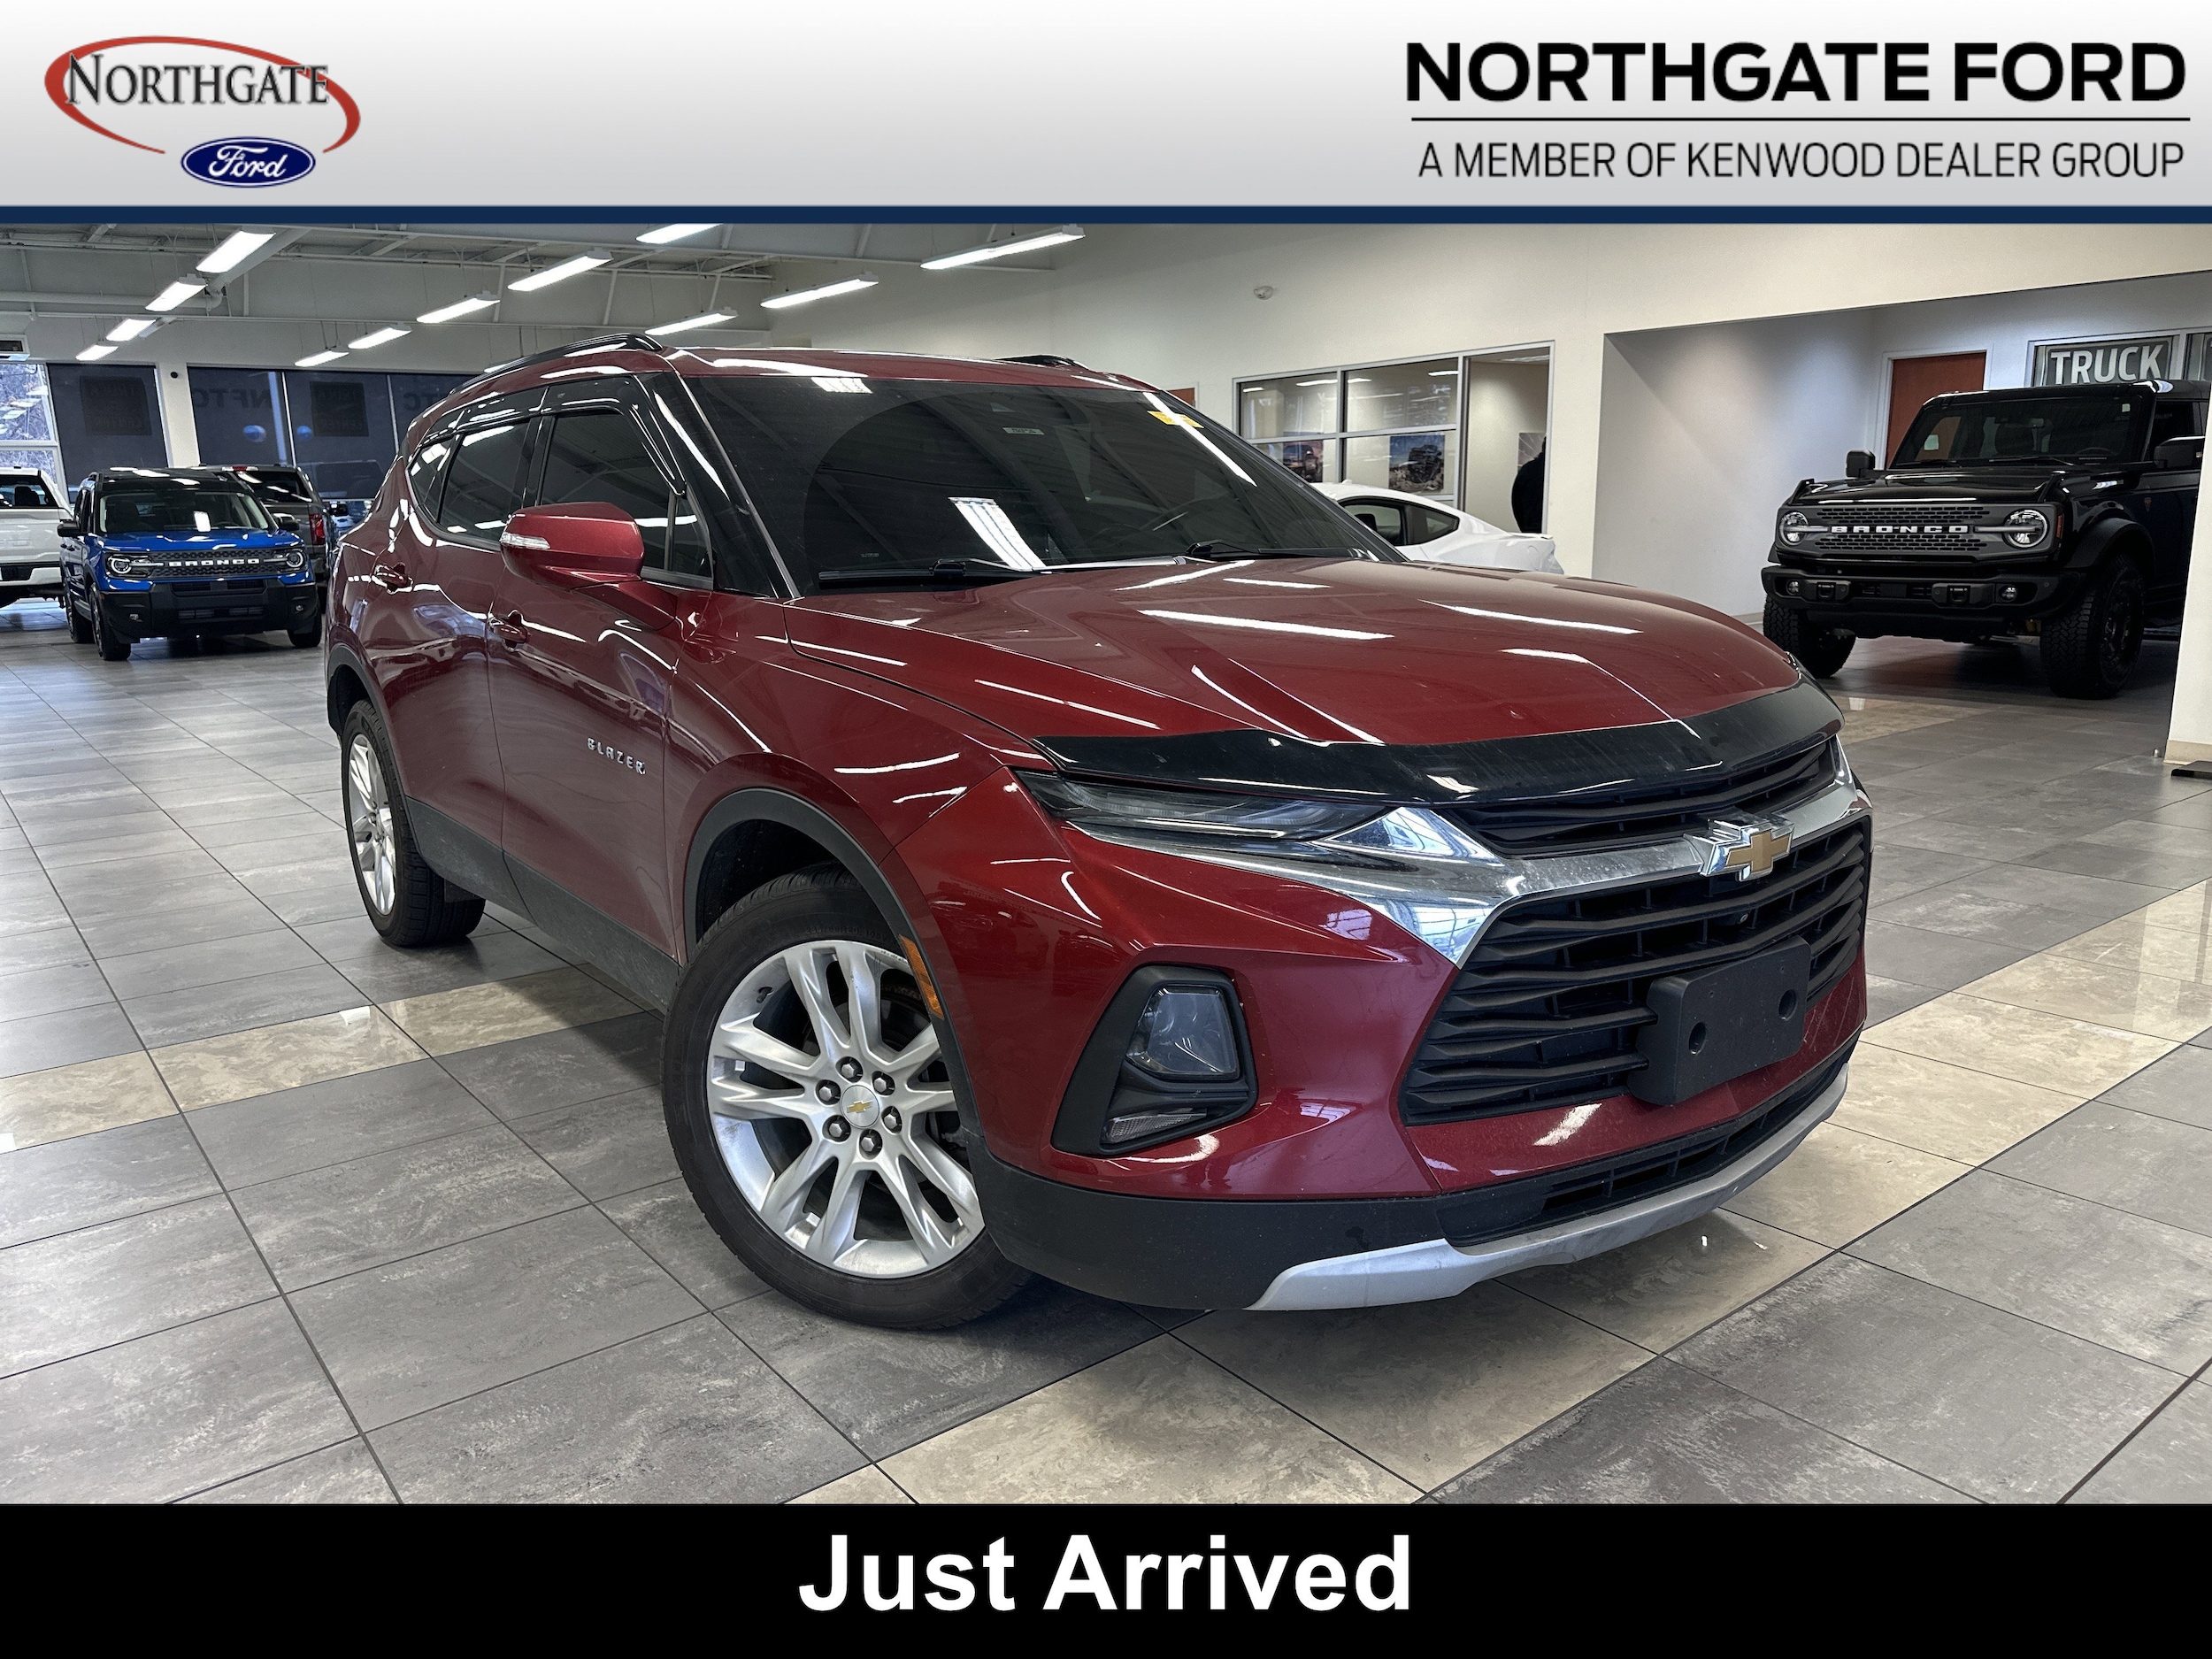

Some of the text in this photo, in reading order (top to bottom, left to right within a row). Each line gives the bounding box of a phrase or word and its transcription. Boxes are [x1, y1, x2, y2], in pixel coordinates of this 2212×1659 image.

[2050, 344, 2164, 385] TRUCK
[1831, 525, 1969, 534] BRONCO
[168, 557, 260, 567] BRONCO
[587, 737, 647, 775] BLAZER
